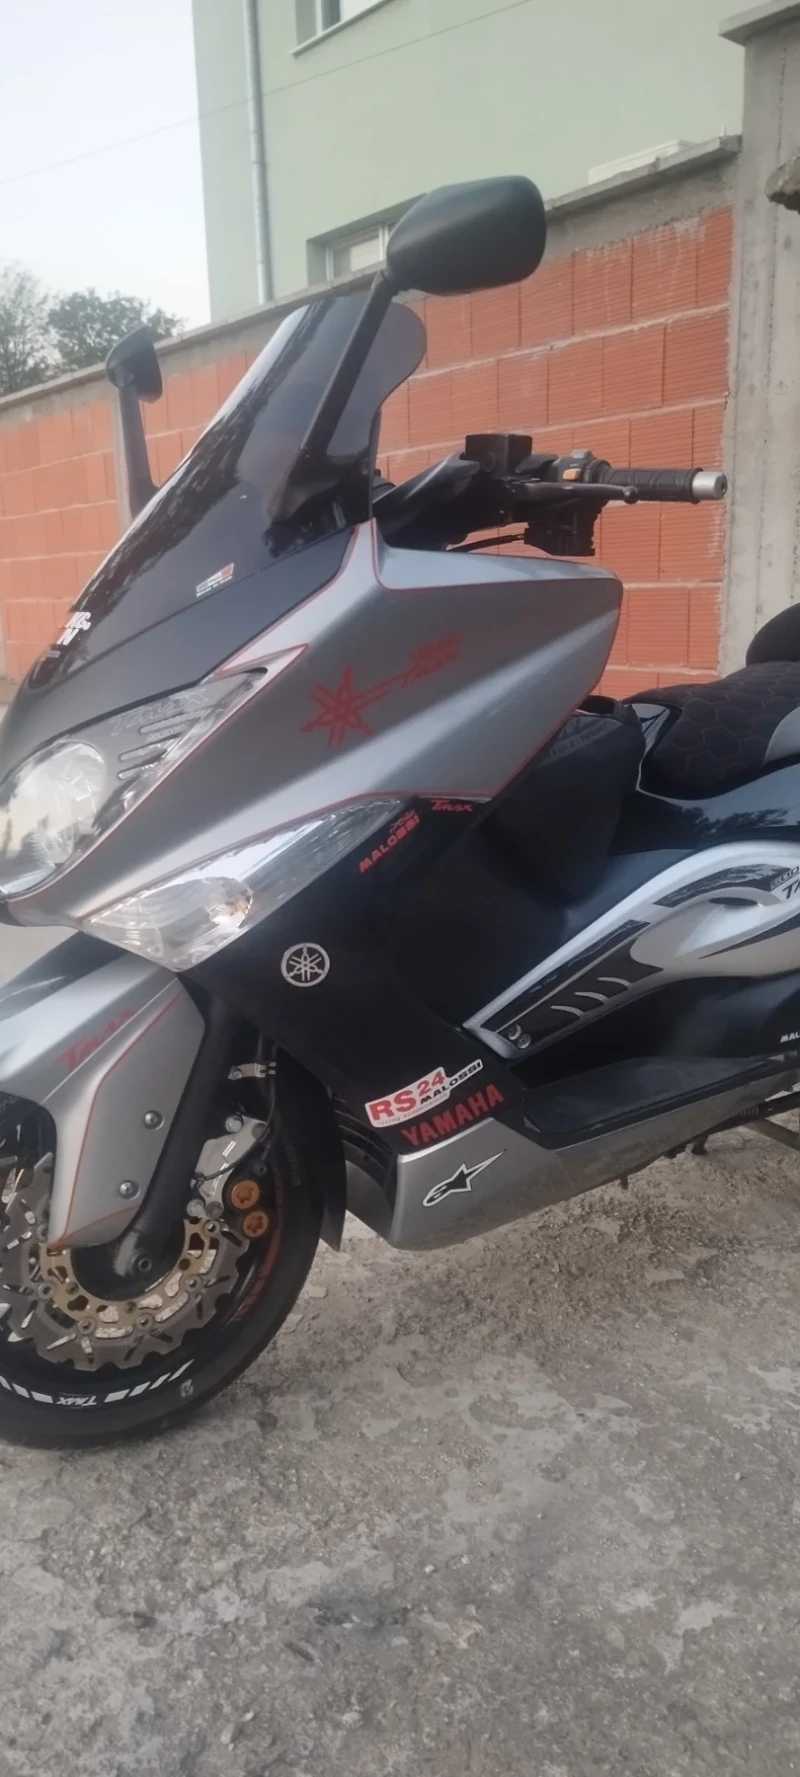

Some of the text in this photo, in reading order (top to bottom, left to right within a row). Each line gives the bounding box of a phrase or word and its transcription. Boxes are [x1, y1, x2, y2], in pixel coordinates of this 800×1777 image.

[359, 814, 420, 873] MALOSSI
[369, 1071, 445, 1121] RS 24
[420, 1061, 481, 1105] MALOSSI
[401, 1084, 504, 1146] YAMAHA
